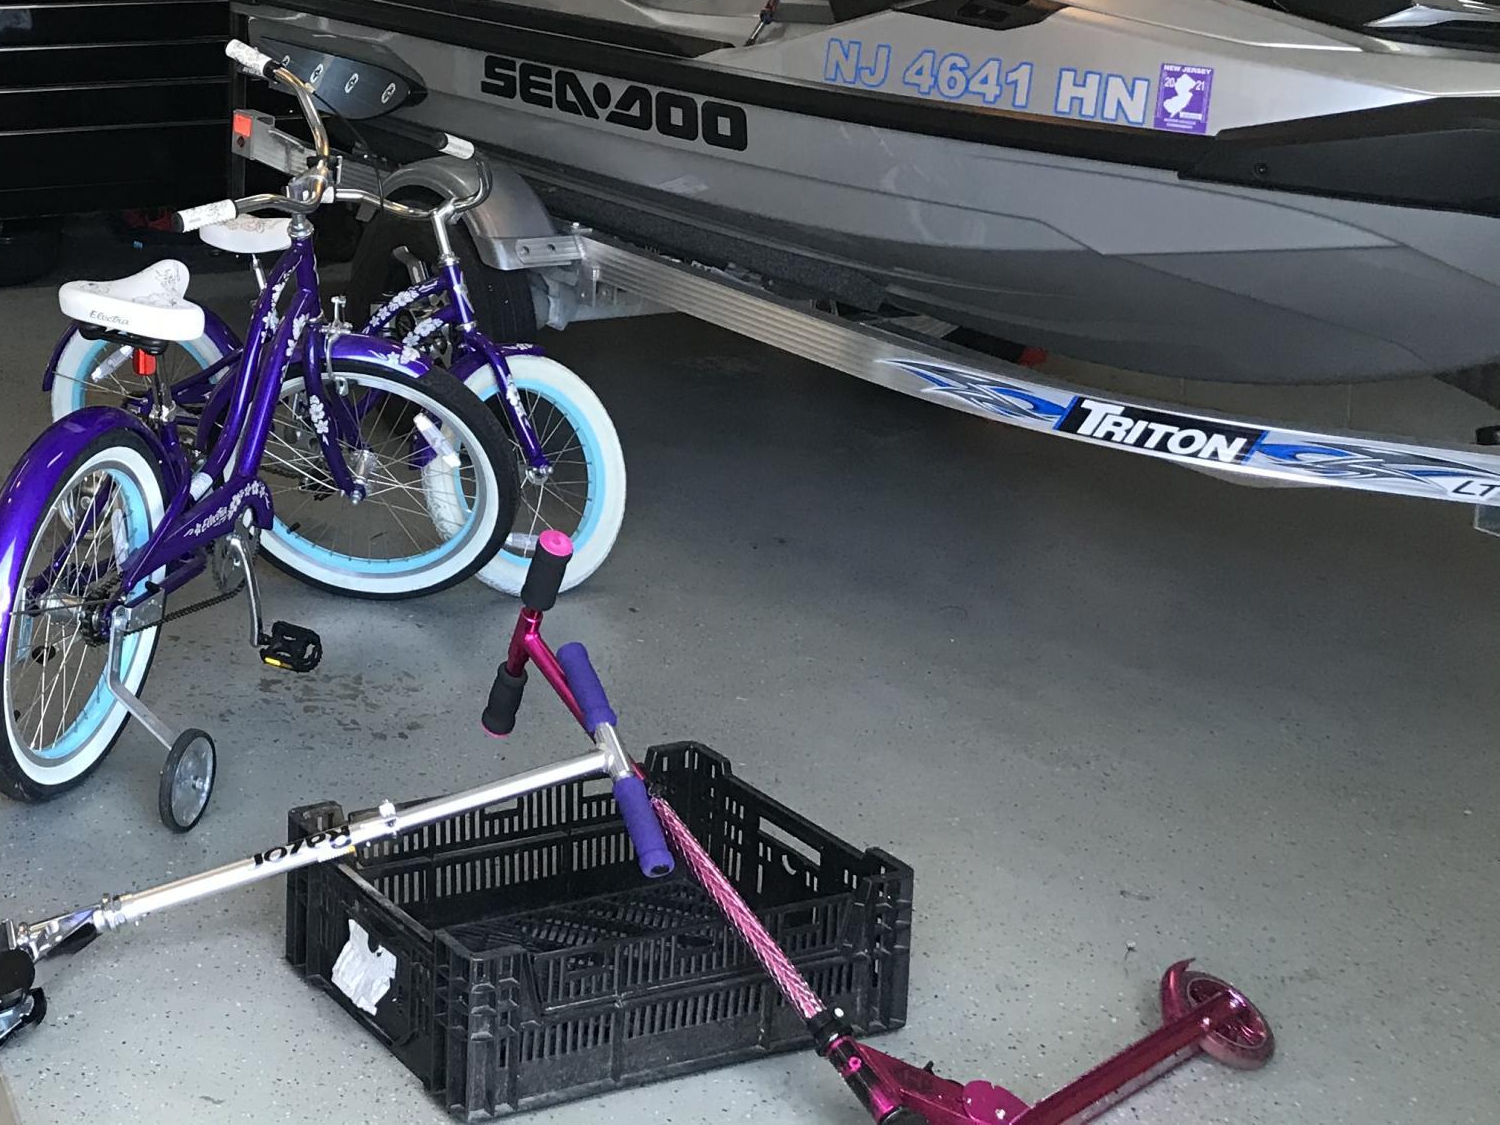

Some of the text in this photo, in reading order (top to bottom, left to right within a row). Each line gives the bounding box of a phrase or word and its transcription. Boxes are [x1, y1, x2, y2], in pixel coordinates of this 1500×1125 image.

[824, 38, 1151, 125] NJ 4641 HN
[1164, 77, 1205, 91] 20 21
[90, 310, 129, 325] Electra
[1080, 399, 1247, 462] TRITON
[254, 825, 352, 866] Razor
